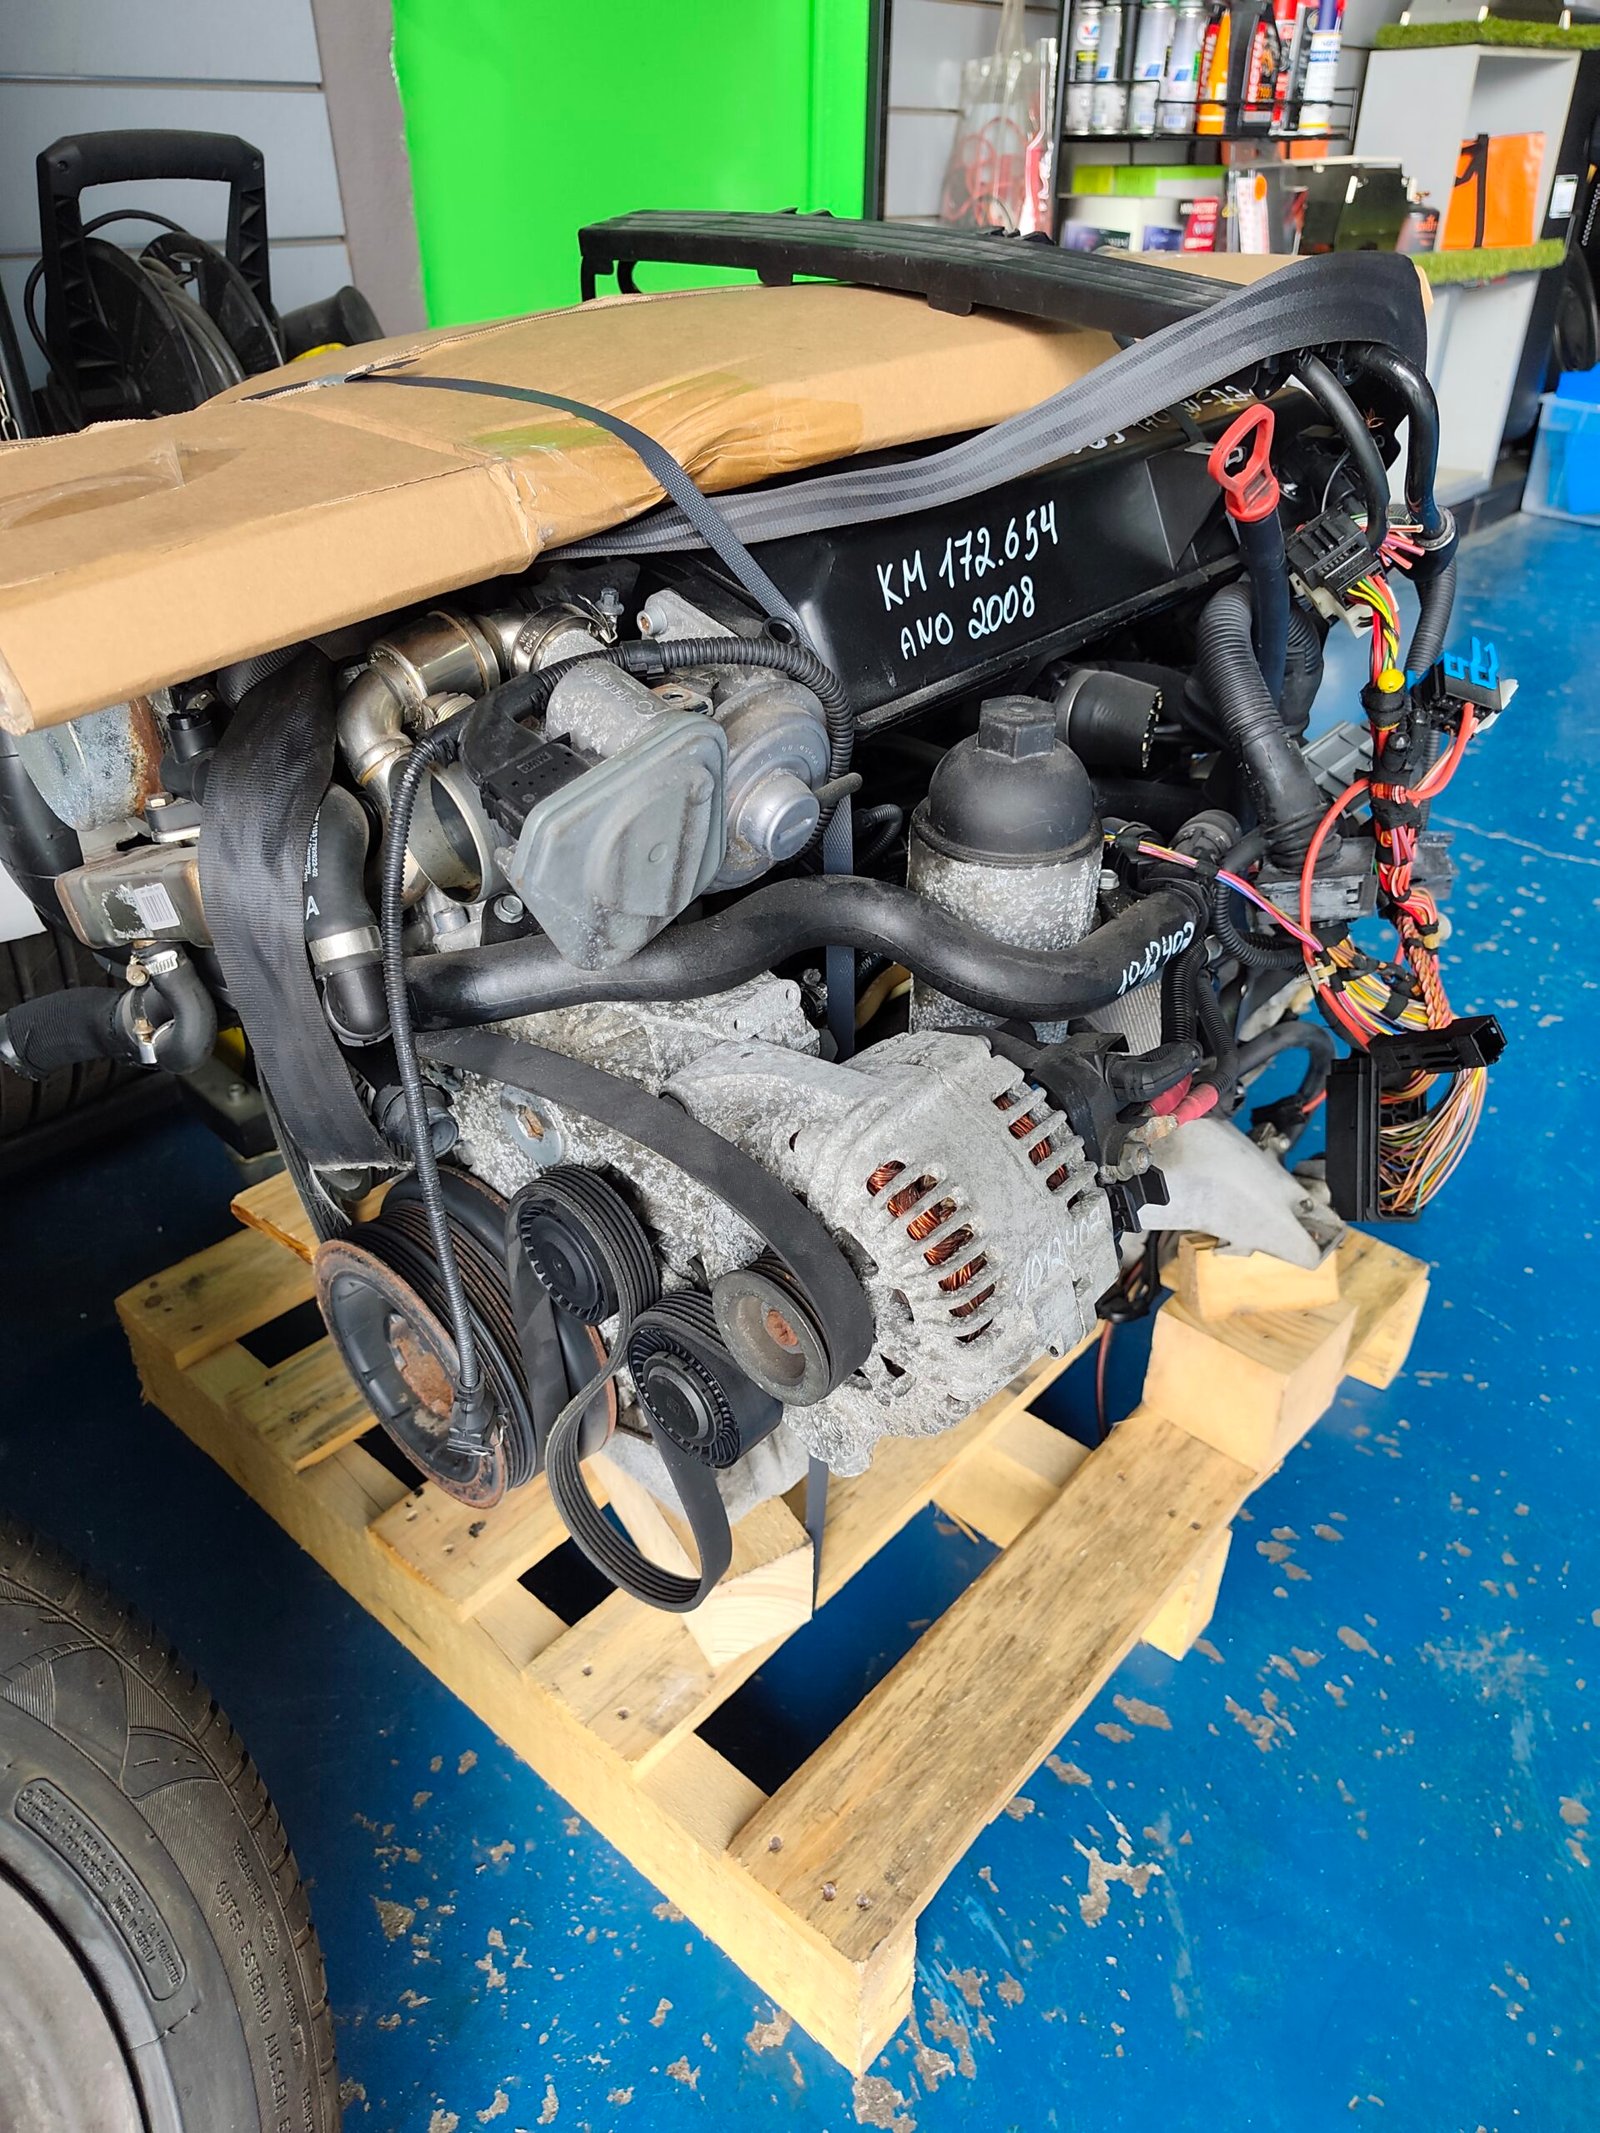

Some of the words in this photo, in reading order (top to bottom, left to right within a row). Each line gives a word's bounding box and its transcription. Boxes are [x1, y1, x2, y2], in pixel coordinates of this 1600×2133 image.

[876, 549, 927, 612] KM
[938, 500, 1058, 588] 172.654
[900, 612, 954, 661] ANO
[968, 575, 1035, 640] 2008
[306, 895, 320, 921] A
[215, 1880, 246, 1938] OUTER
[239, 1939, 273, 2027] ESTERNO
[263, 2031, 290, 2115] AUSSEN
